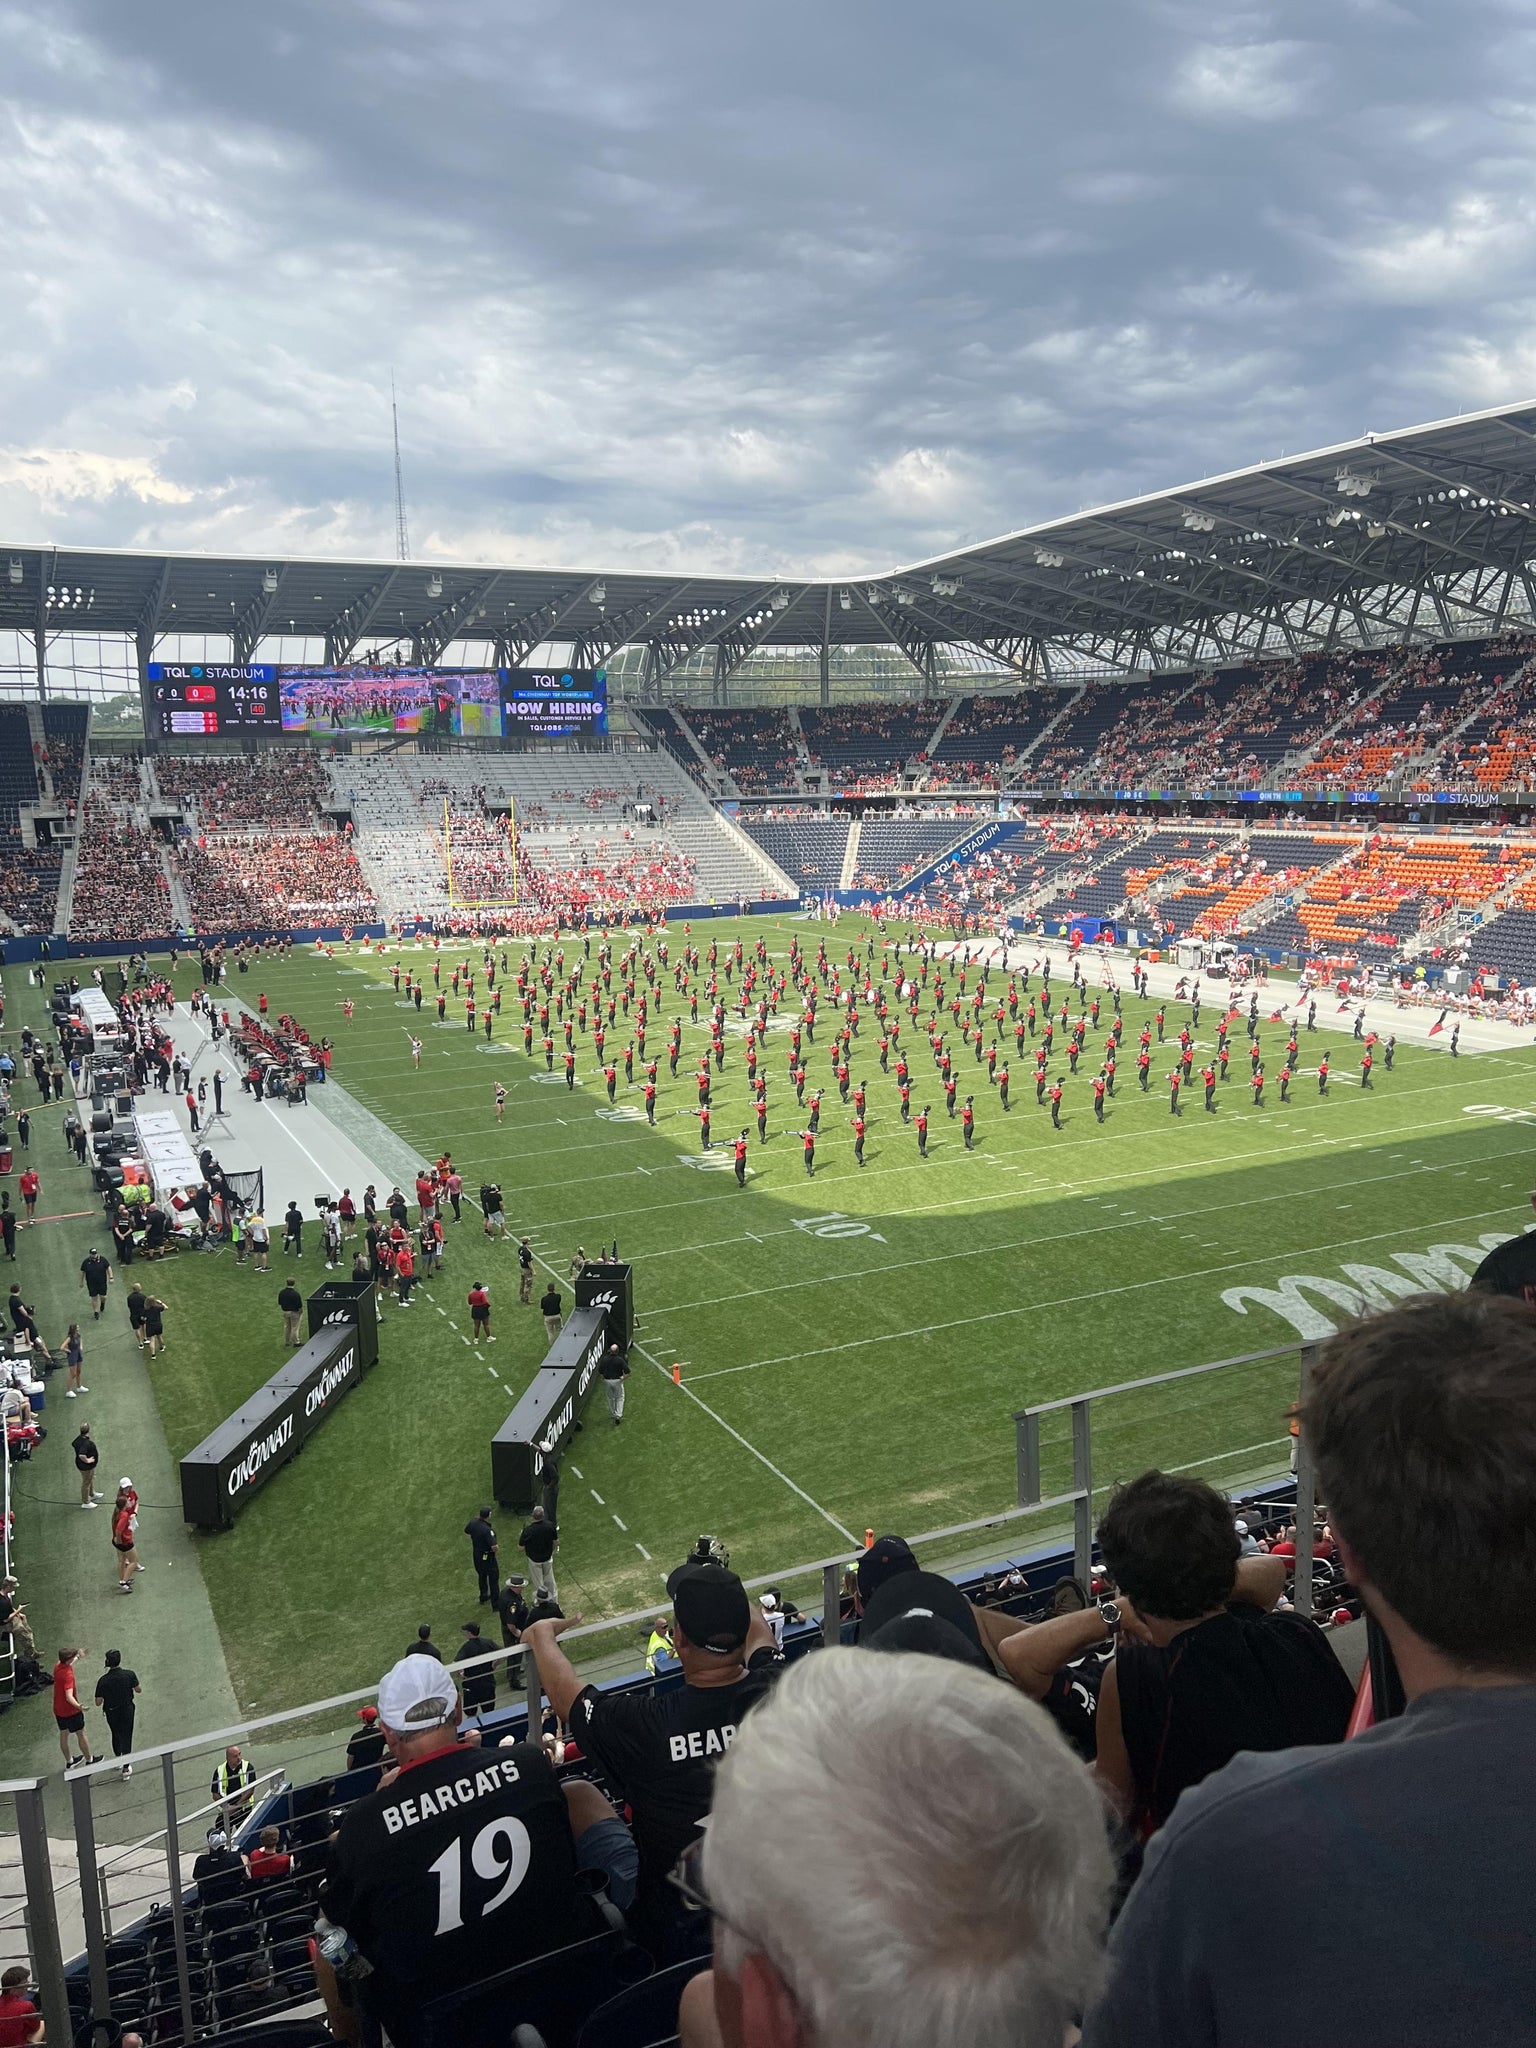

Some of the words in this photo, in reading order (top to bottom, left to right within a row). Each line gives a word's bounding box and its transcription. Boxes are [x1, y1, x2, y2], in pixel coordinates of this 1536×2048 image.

[164, 667, 190, 678] TQL
[206, 667, 265, 679] STADIUM
[532, 675, 560, 687] TQL
[170, 688, 178, 697] 0
[192, 688, 199, 697] 0
[228, 686, 268, 699] 14:16
[252, 705, 264, 713] 40
[505, 702, 544, 714] NOW
[549, 702, 603, 714] HIRING
[1063, 791, 1074, 799] TQL
[1190, 792, 1205, 800] TQL
[1354, 793, 1371, 802] TQL
[1417, 793, 1436, 803] TQL
[1449, 794, 1499, 804] STADIUM
[933, 859, 955, 876] TQL
[961, 823, 1001, 857] STADIUM
[1458, 913, 1474, 923] TQL
[790, 1211, 872, 1238] 10
[305, 1347, 354, 1417] CINCINNATI
[227, 1412, 294, 1496] CINCINNATI
[382, 1759, 521, 1835] BEARCATS
[427, 1815, 531, 1937] 19
